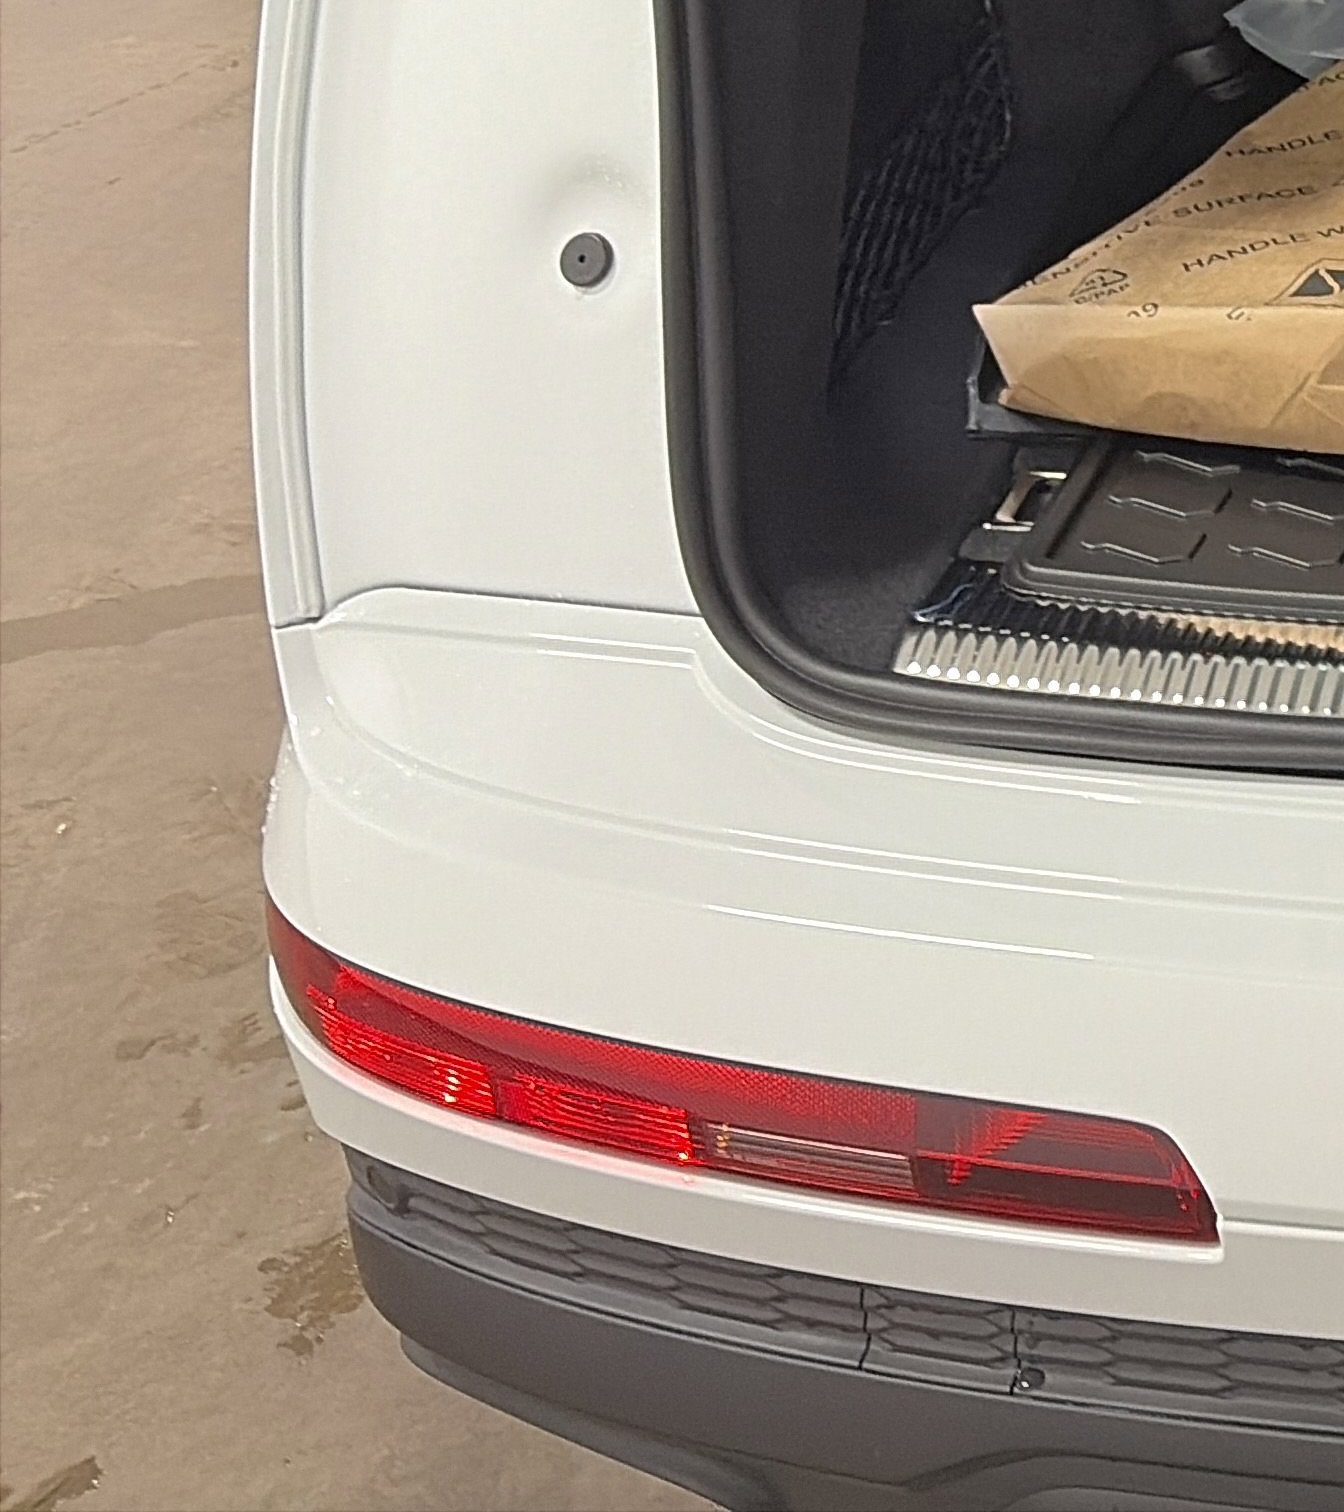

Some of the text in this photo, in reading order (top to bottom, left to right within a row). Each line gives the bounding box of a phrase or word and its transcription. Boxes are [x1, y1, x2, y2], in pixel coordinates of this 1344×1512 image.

[1225, 129, 1344, 158] HANDLE
[1172, 184, 1316, 219] SURFACE
[1182, 232, 1311, 272] HANDLE
